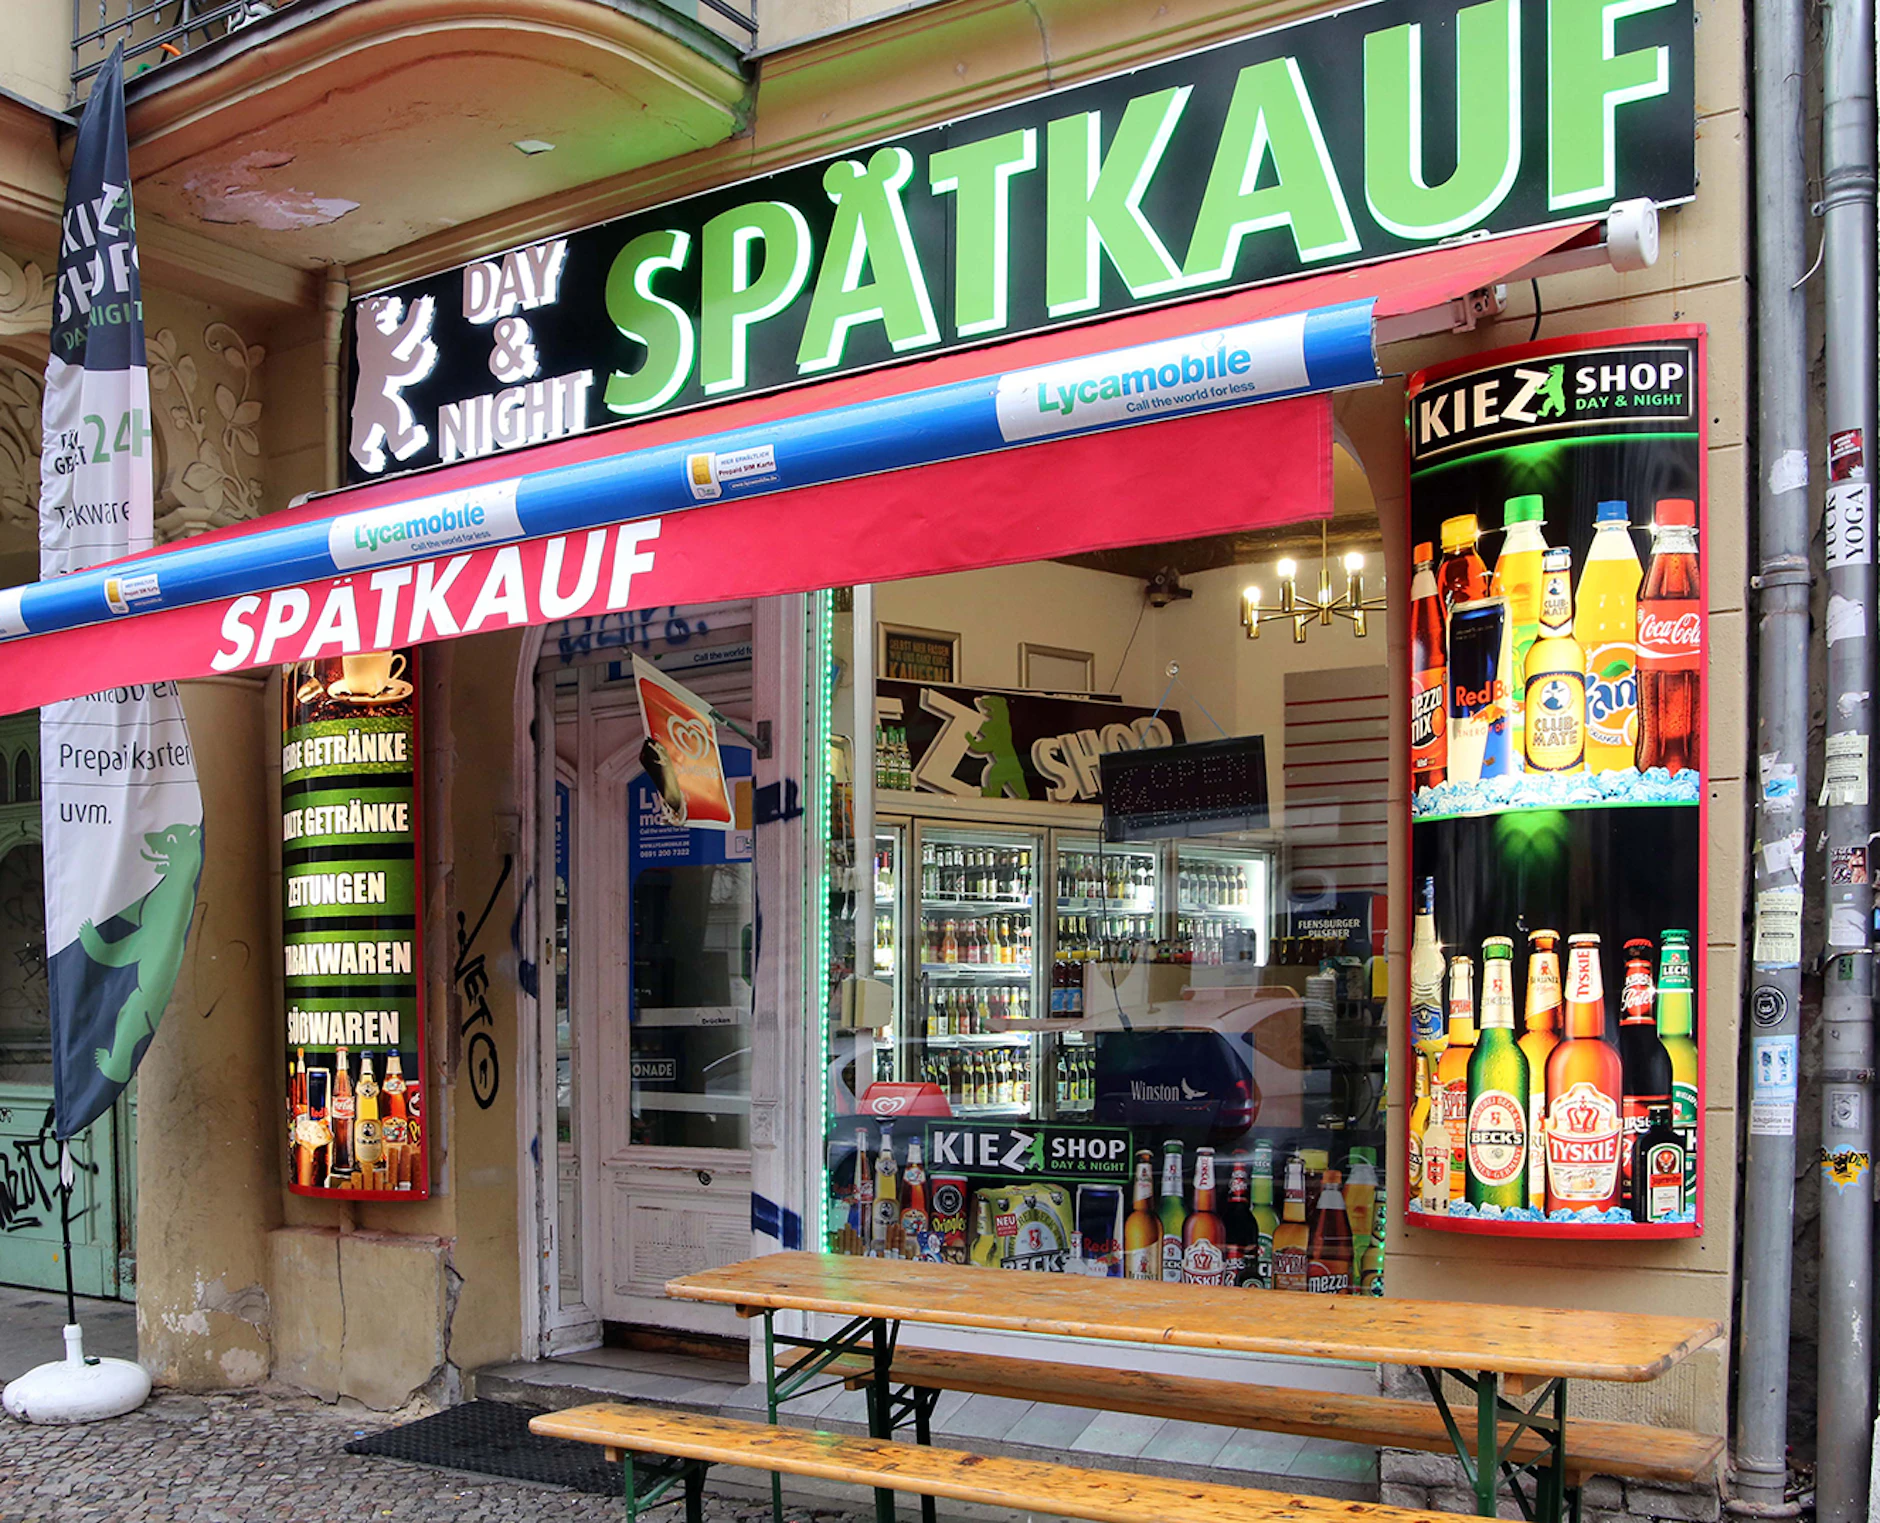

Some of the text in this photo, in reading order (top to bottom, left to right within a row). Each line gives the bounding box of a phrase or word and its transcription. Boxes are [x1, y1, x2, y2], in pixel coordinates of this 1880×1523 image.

[603, 0, 1677, 416] SPÄTKAUF
[463, 239, 568, 325] DAY
[62, 327, 91, 350] DA
[489, 317, 539, 383] &
[1038, 346, 1251, 415] Lycamobile
[1126, 380, 1255, 413] Call the world for less
[438, 369, 593, 464] NIGHT
[1420, 362, 1684, 444] KIEZ SHOP
[1575, 393, 1683, 411] DAY & NIGHT
[354, 503, 485, 551] Lycamobile
[1844, 486, 1865, 560] YOGA
[411, 530, 491, 551] Call the world for less
[210, 518, 661, 672] SPÄTKAUF
[1638, 613, 1700, 646] Coca-Cola
[694, 651, 708, 662] Call
[709, 650, 723, 660] the
[724, 648, 746, 659] world
[1455, 680, 1491, 707] Red
[304, 728, 408, 767] GETRÄNKE
[1532, 731, 1578, 747] MATE
[1151, 752, 1247, 788] OPEN
[60, 803, 112, 825] uvm.
[304, 798, 409, 837] GETRÄNKE
[287, 871, 386, 908] ZEITUNGEN
[1298, 918, 1361, 929] FLENSBURGER
[1308, 928, 1350, 939] PILSENER
[1576, 950, 1590, 997] TYSKIE
[1663, 965, 1688, 976] LECH
[1130, 1079, 1180, 1102] Winston
[933, 1129, 1126, 1173] KIEZ SHOP
[1471, 1131, 1523, 1145] BECK'S
[1550, 1138, 1615, 1161] TYSKIE
[1051, 1160, 1125, 1172] DAY & NIGHT
[996, 1215, 1015, 1227] NEU
[1308, 1274, 1349, 1292] mezzo
